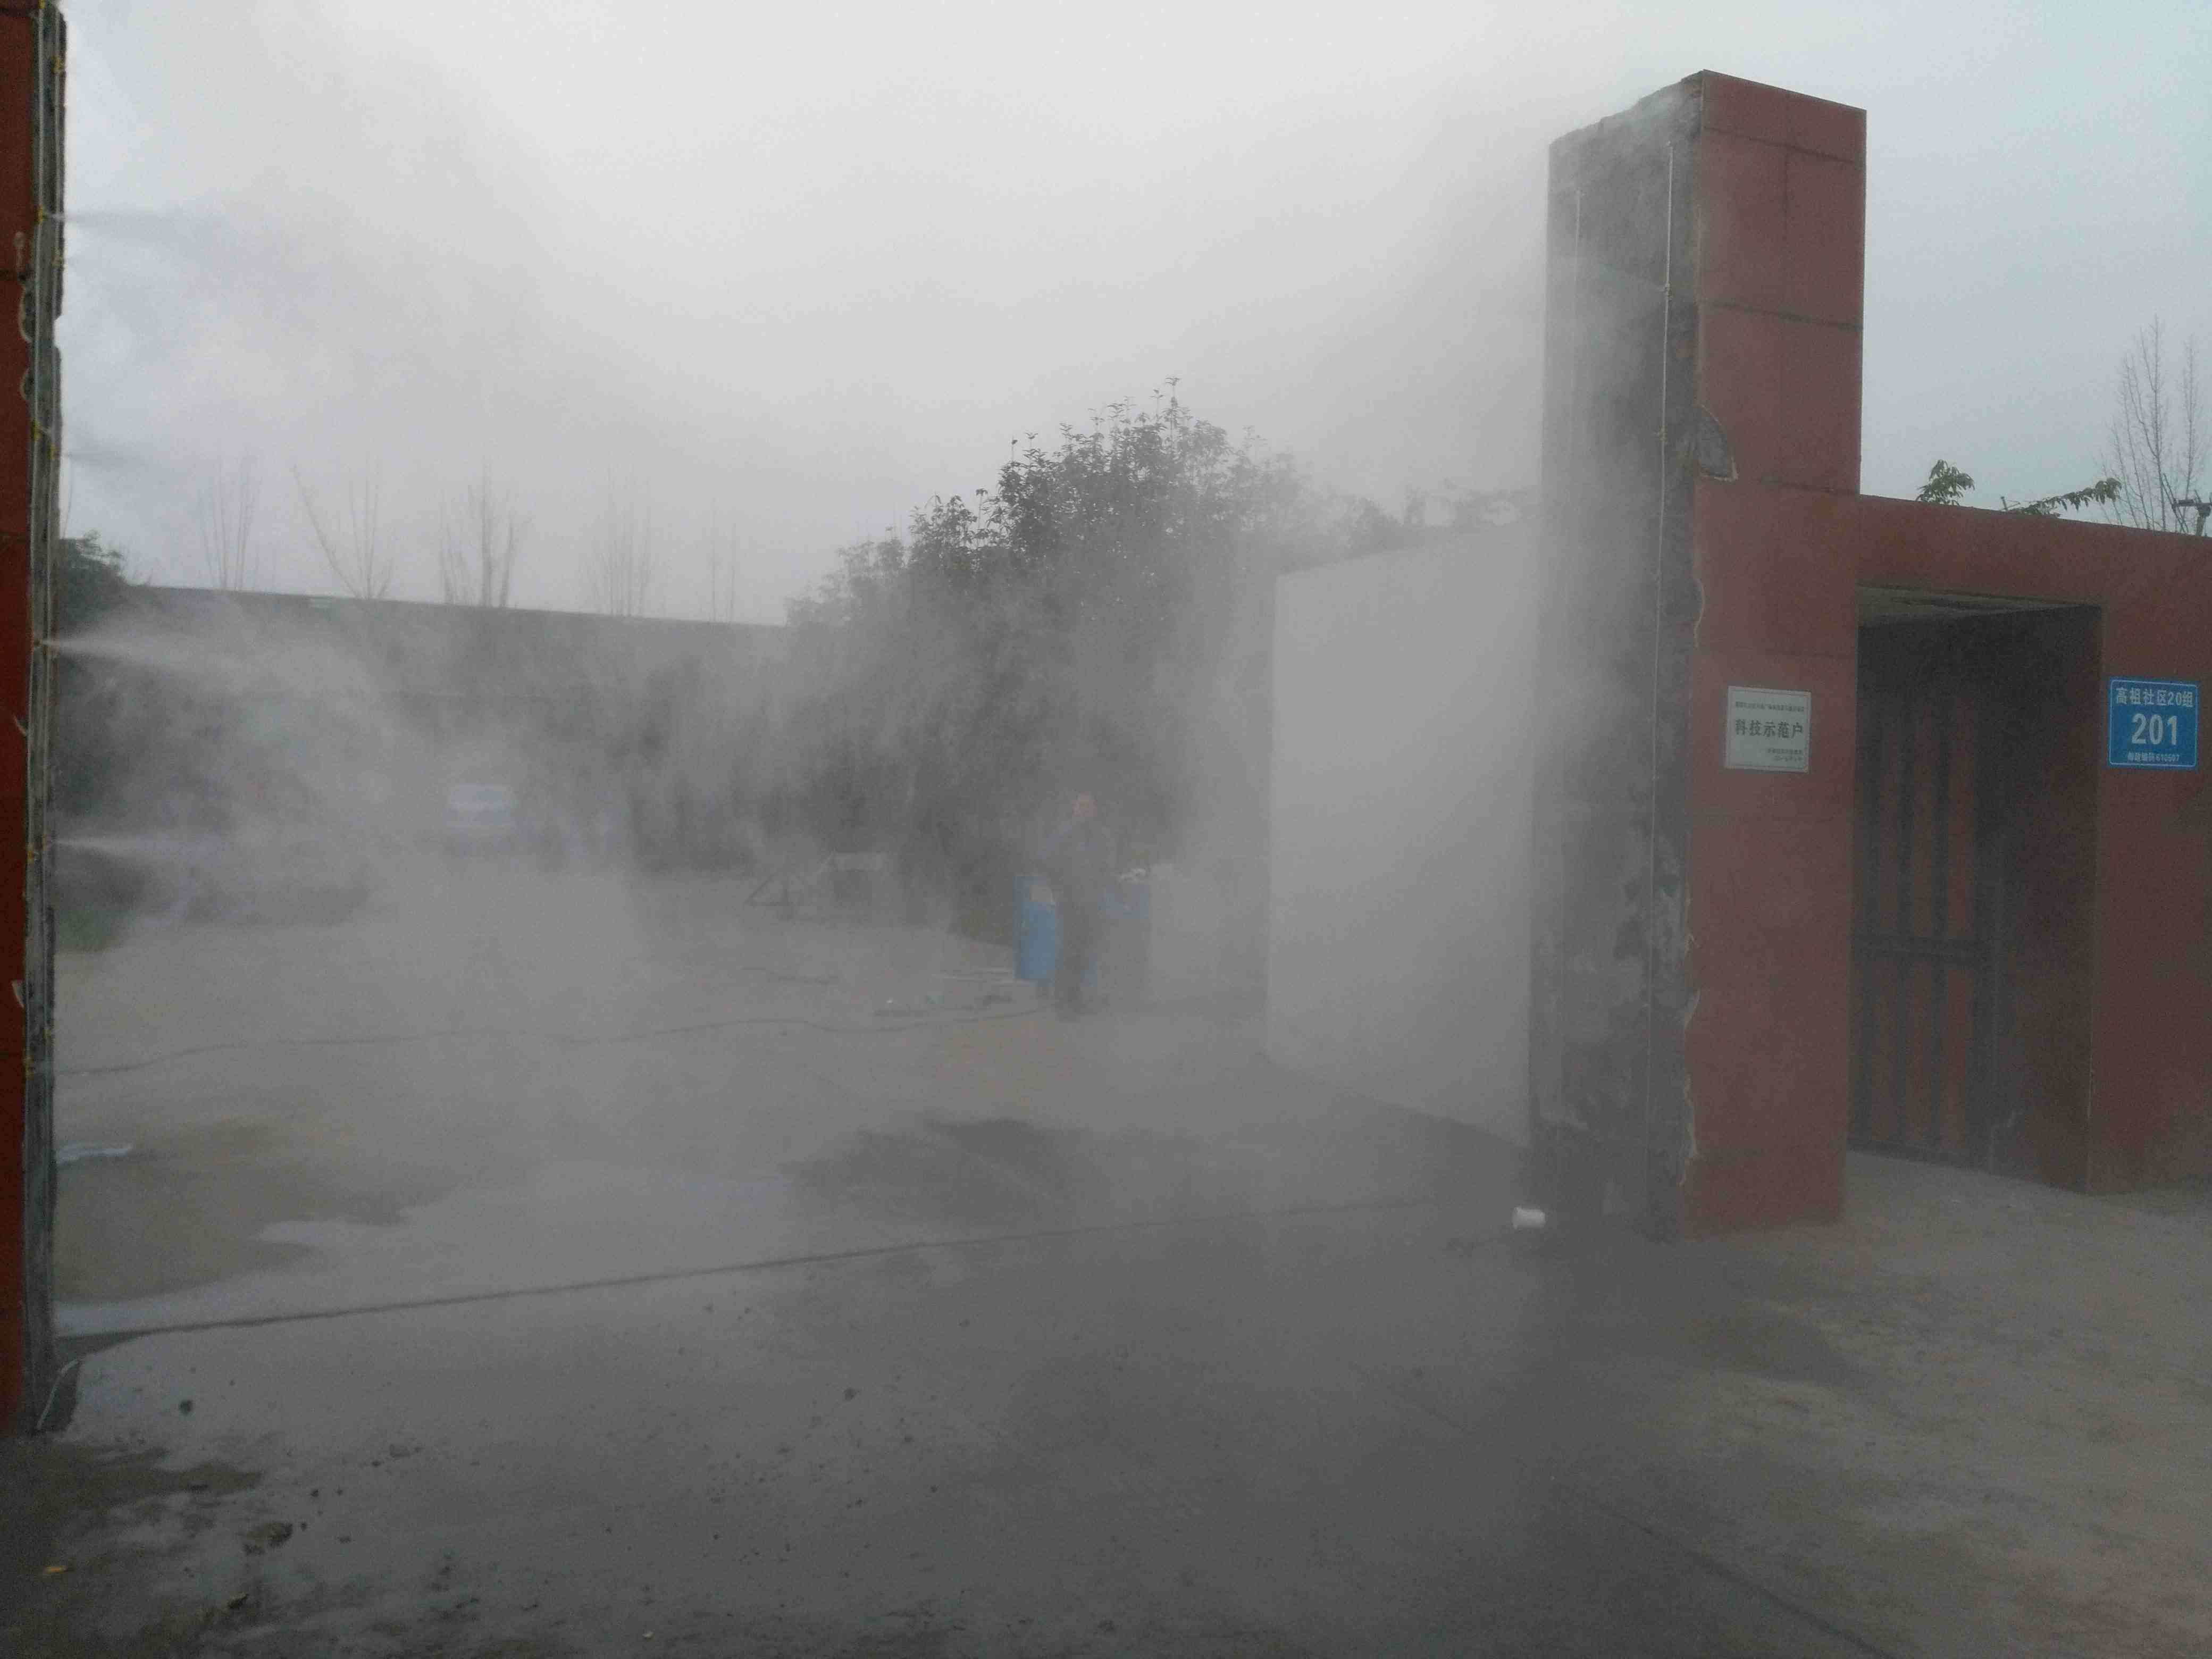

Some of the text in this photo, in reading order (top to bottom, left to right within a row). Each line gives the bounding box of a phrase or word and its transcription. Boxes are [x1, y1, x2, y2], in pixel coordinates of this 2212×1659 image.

[1735, 719, 1803, 739] 科技示范户
[2131, 713, 2178, 745] 201
